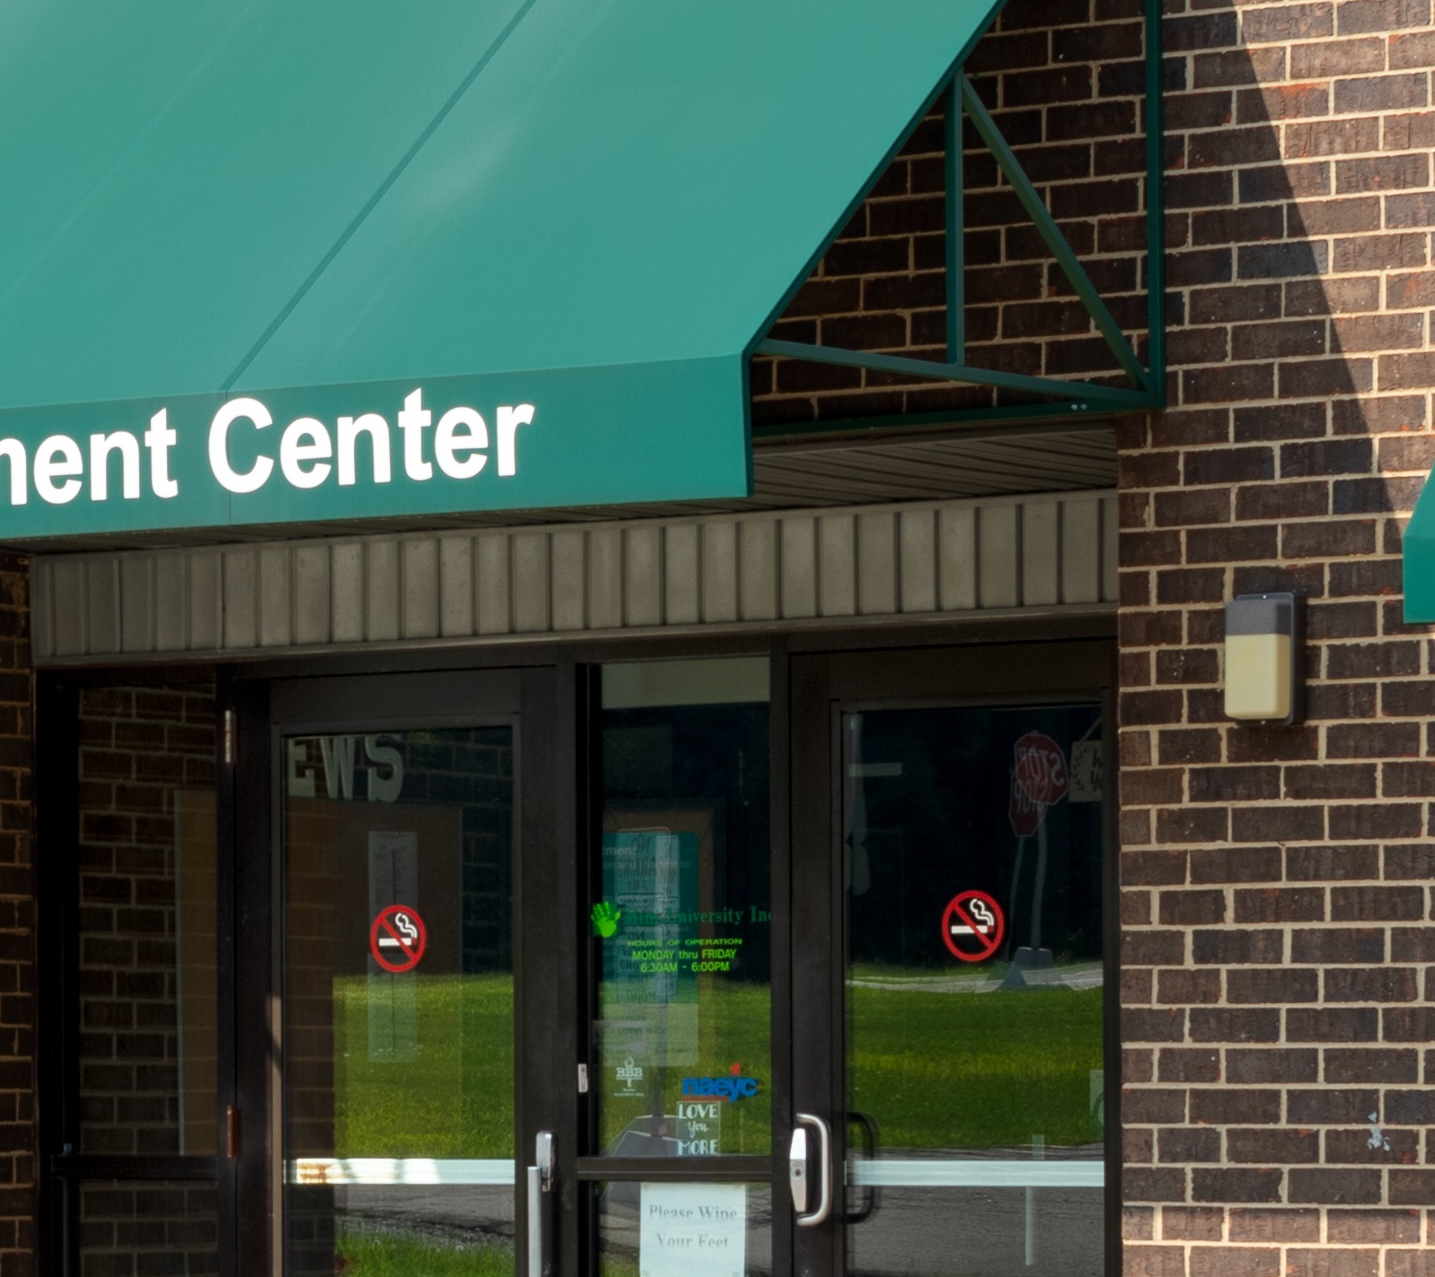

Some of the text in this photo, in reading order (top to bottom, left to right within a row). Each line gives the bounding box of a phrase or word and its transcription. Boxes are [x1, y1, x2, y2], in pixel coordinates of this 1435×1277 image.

[209, 389, 534, 492] Center
[632, 950, 674, 960] MONDAY
[678, 950, 698, 959] thru
[702, 949, 737, 958] FRIDAY
[640, 962, 678, 972] 6:30AM
[691, 961, 730, 971] 6:00PM
[616, 1067, 643, 1077] BBB
[682, 1076, 757, 1102] naeyc
[678, 1103, 718, 1119] LOVE
[678, 1140, 718, 1155] MORE
[649, 1204, 693, 1219] Please
[656, 1233, 729, 1248] Your Feet
